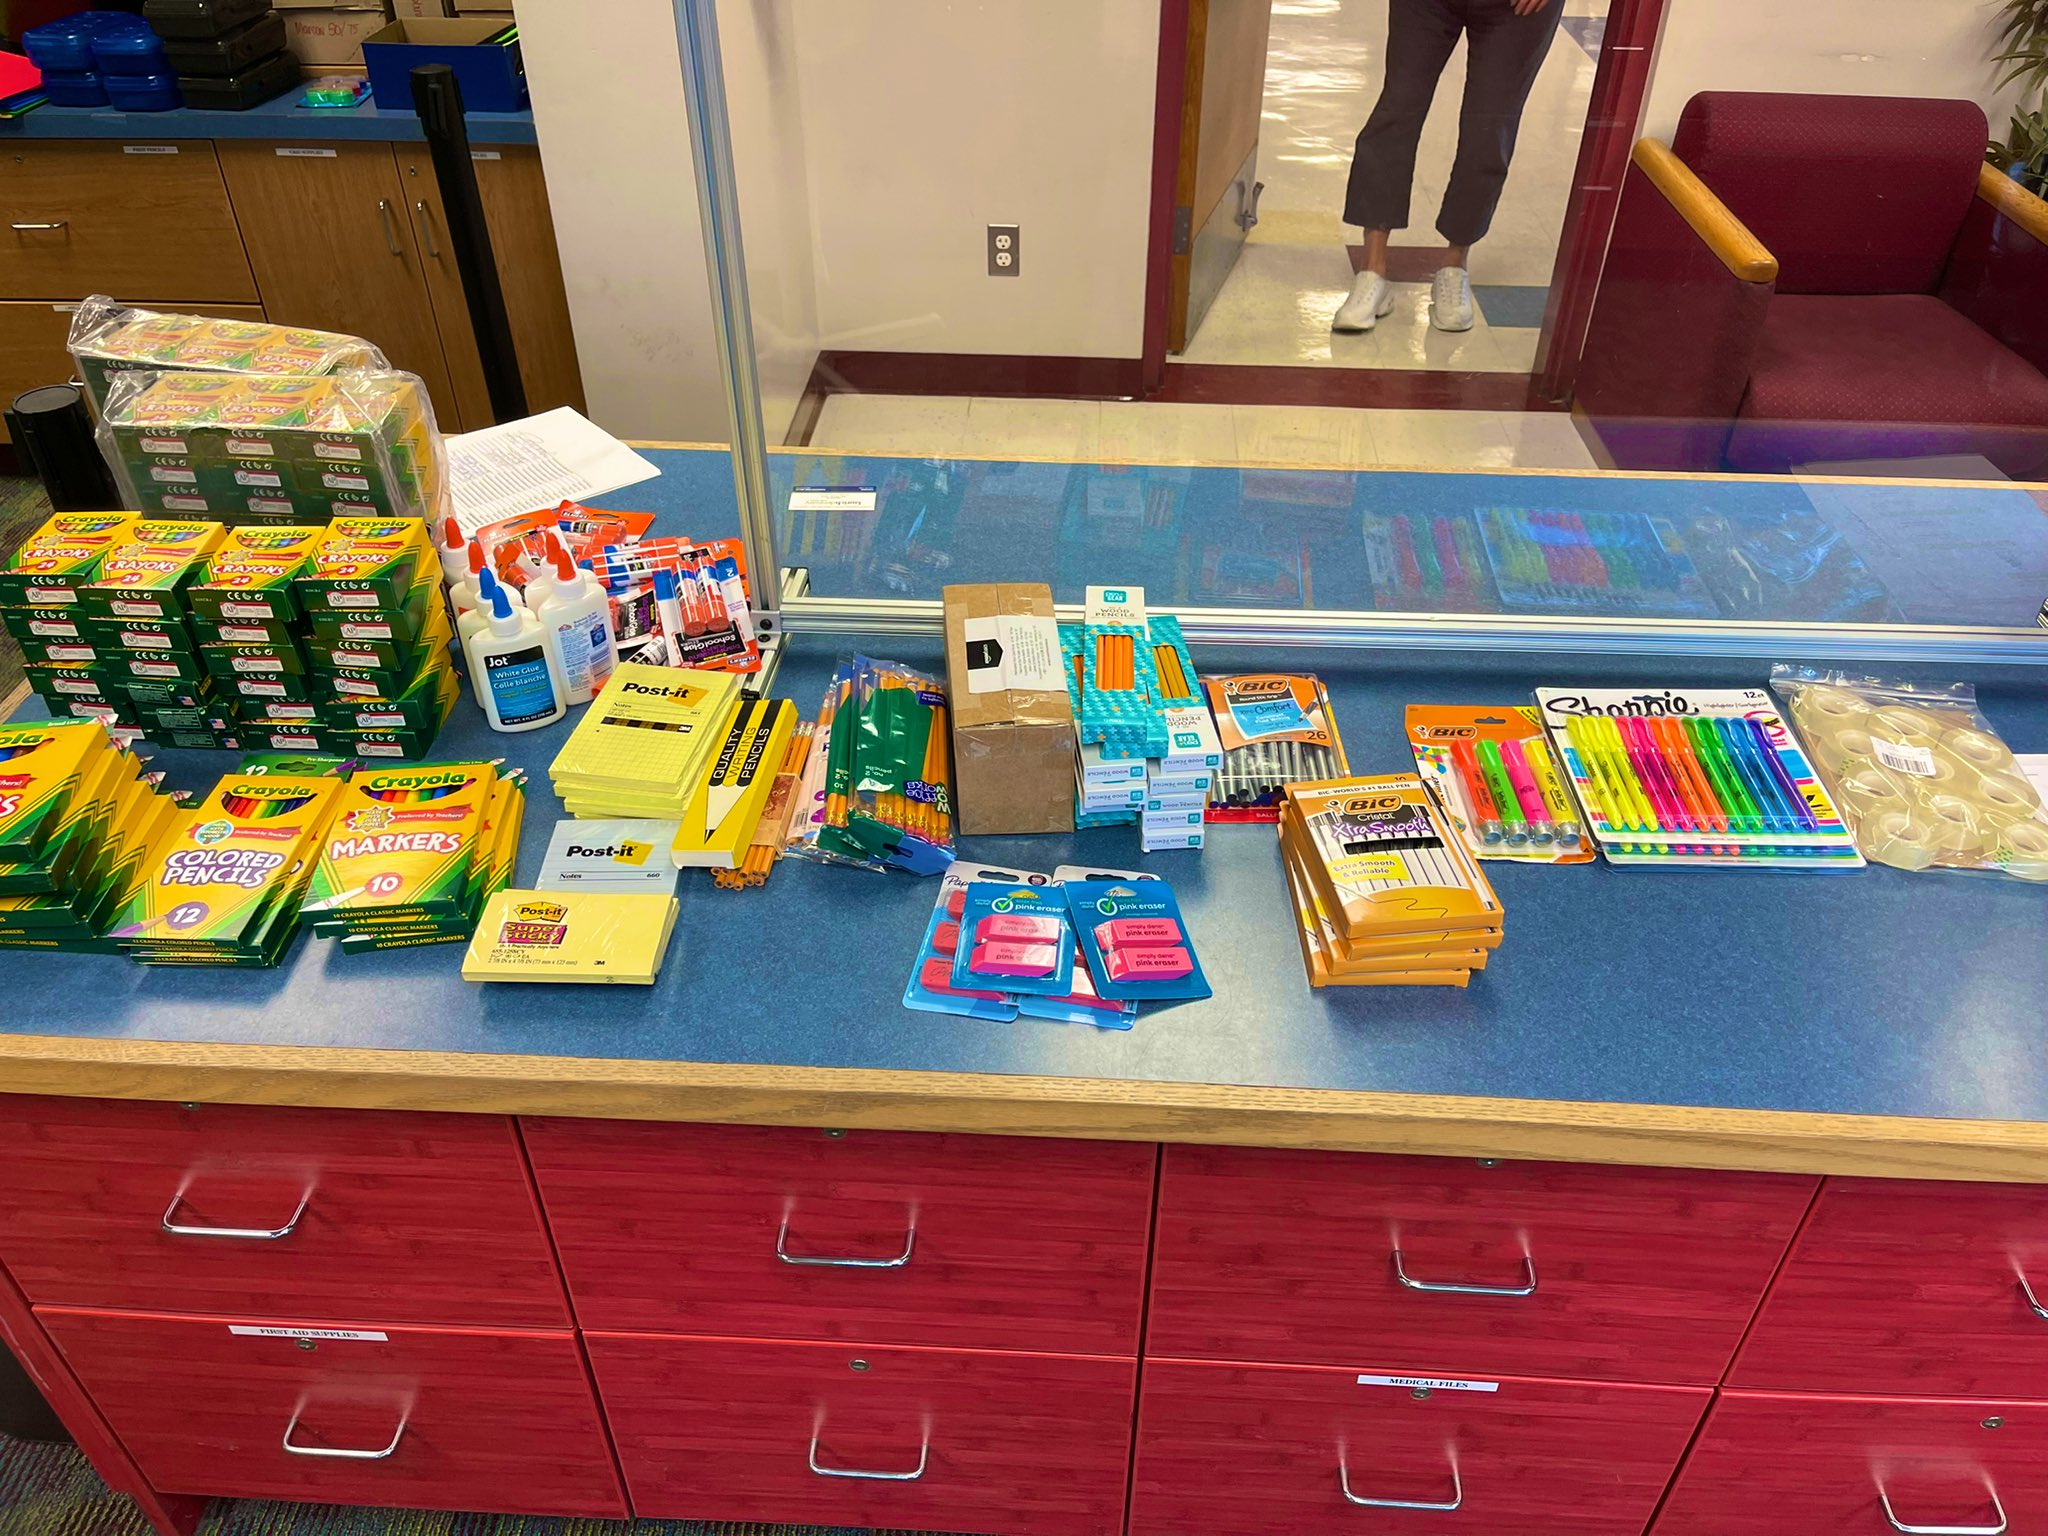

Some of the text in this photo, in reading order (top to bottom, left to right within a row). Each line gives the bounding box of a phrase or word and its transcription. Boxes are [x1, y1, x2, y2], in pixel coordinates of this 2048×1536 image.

[62, 515, 123, 524] Crayola
[343, 519, 406, 529] Crayola
[141, 522, 204, 532] Crayola
[243, 530, 307, 539] Crayola
[23, 548, 92, 559] CRAYONS
[317, 554, 389, 564] CRAYONS
[41, 560, 56, 569] 24
[105, 560, 178, 572] CRAYONS
[212, 564, 285, 575] CRAYONS
[338, 566, 356, 574] 24
[123, 573, 140, 582] 24
[231, 576, 249, 585] 24
[683, 634, 736, 651] School Glue
[489, 656, 508, 667] Jot
[495, 665, 540, 679] White Glue
[493, 674, 546, 690] Colle blanche
[622, 682, 690, 699] Post-it
[1254, 702, 1292, 715] Comfort
[1306, 730, 1328, 740] 26
[712, 728, 742, 779] QUALITY
[726, 727, 757, 779] WRITING
[740, 728, 770, 779] PENCILS
[371, 773, 466, 790] Crayola
[232, 784, 311, 797] Crayola
[1357, 813, 1396, 821] Cristal
[332, 832, 463, 860] MARKERS
[566, 845, 635, 857] Post-it
[167, 851, 284, 868] COLORED
[1333, 863, 1358, 872] Extra
[1351, 868, 1390, 876] Reliable
[163, 866, 268, 888] PENCILS
[371, 876, 399, 892] 10
[520, 907, 562, 916] Post-it
[1015, 903, 1066, 913] pink eraser
[1119, 902, 1166, 911] pink eraser
[173, 907, 201, 923] 12
[505, 923, 562, 933] Super
[1125, 929, 1143, 937] pink
[437, 934, 465, 942] MARKERS
[505, 931, 560, 944] Sticky
[995, 953, 1015, 961] pink
[1135, 959, 1153, 967] pink
[311, 1330, 359, 1338] SUPPLIES
[1389, 1378, 1437, 1387] MEDICAL
